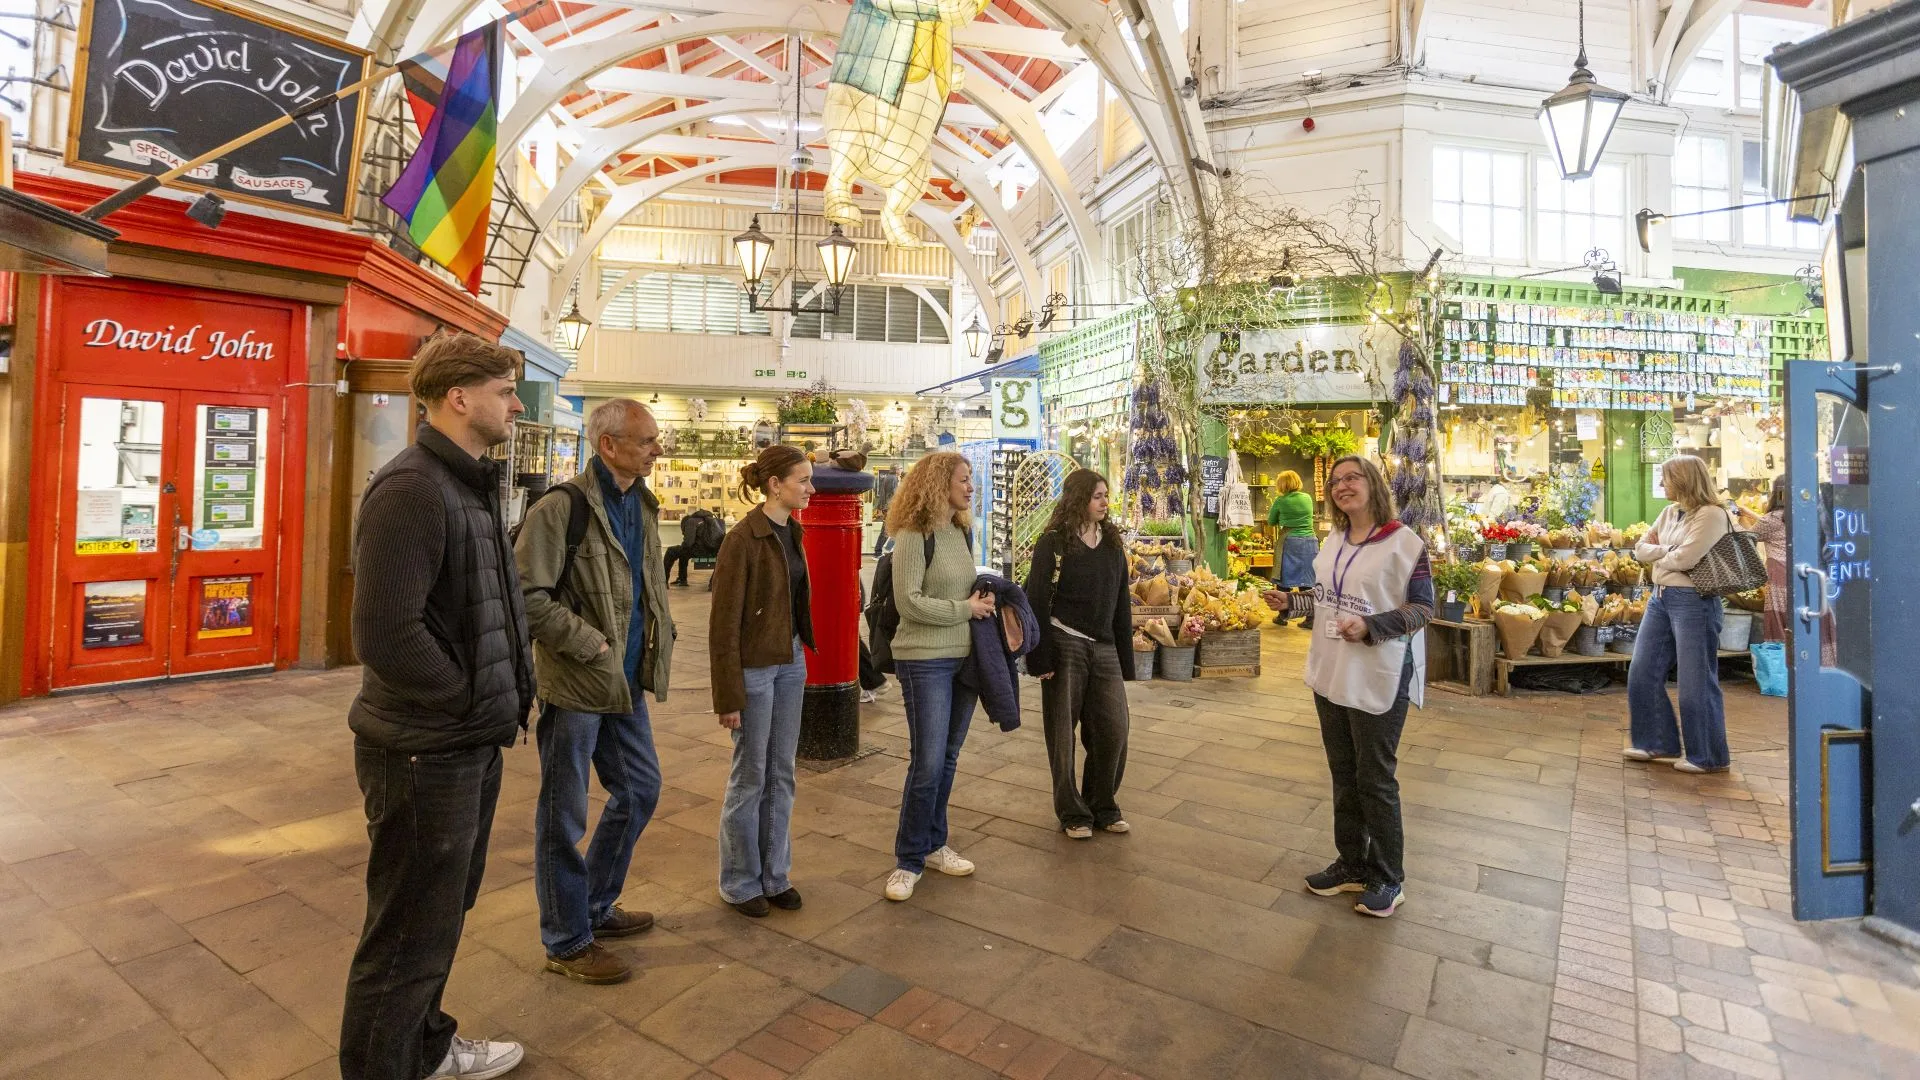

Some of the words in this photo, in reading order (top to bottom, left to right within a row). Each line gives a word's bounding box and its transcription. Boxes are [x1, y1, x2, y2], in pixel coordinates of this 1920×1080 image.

[113, 38, 251, 111] David
[257, 57, 328, 137] John
[136, 142, 212, 177] SPECIAITY
[237, 175, 305, 188] SAUSAGES
[84, 318, 202, 355] David
[200, 330, 275, 361] John
[1204, 340, 1359, 389] garden
[1001, 380, 1032, 428] g
[1835, 509, 1870, 535] PUL
[1828, 541, 1856, 561] TO
[1829, 562, 1871, 582] ENTE
